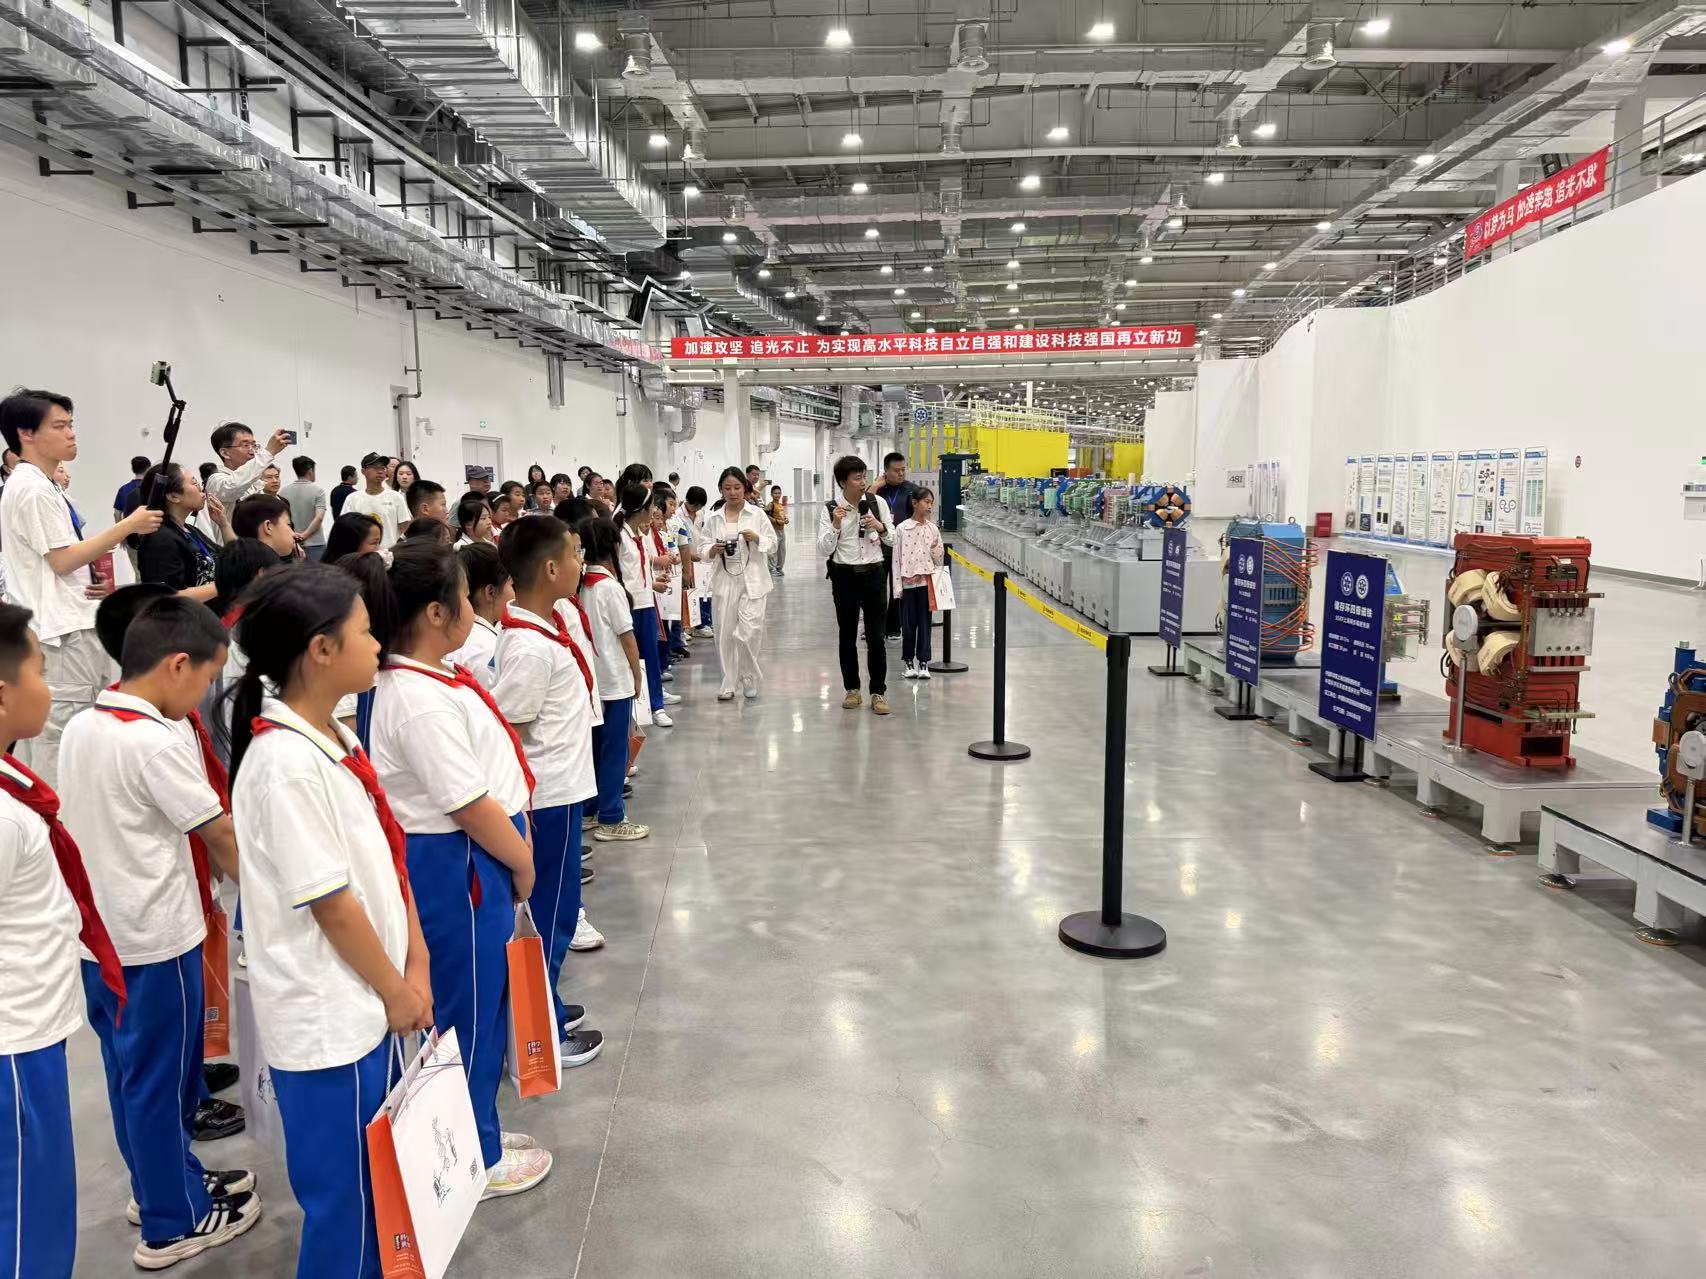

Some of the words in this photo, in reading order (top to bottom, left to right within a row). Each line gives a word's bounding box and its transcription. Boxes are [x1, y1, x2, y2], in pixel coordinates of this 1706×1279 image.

[1483, 205, 1514, 240] 以梦为马
[1516, 185, 1553, 223] 加速奔跑
[685, 340, 743, 355] 加速攻坚
[751, 339, 809, 355] 追光不止
[817, 328, 1182, 354] 为实现高水平科技自立自强和建设科技强国再立新功
